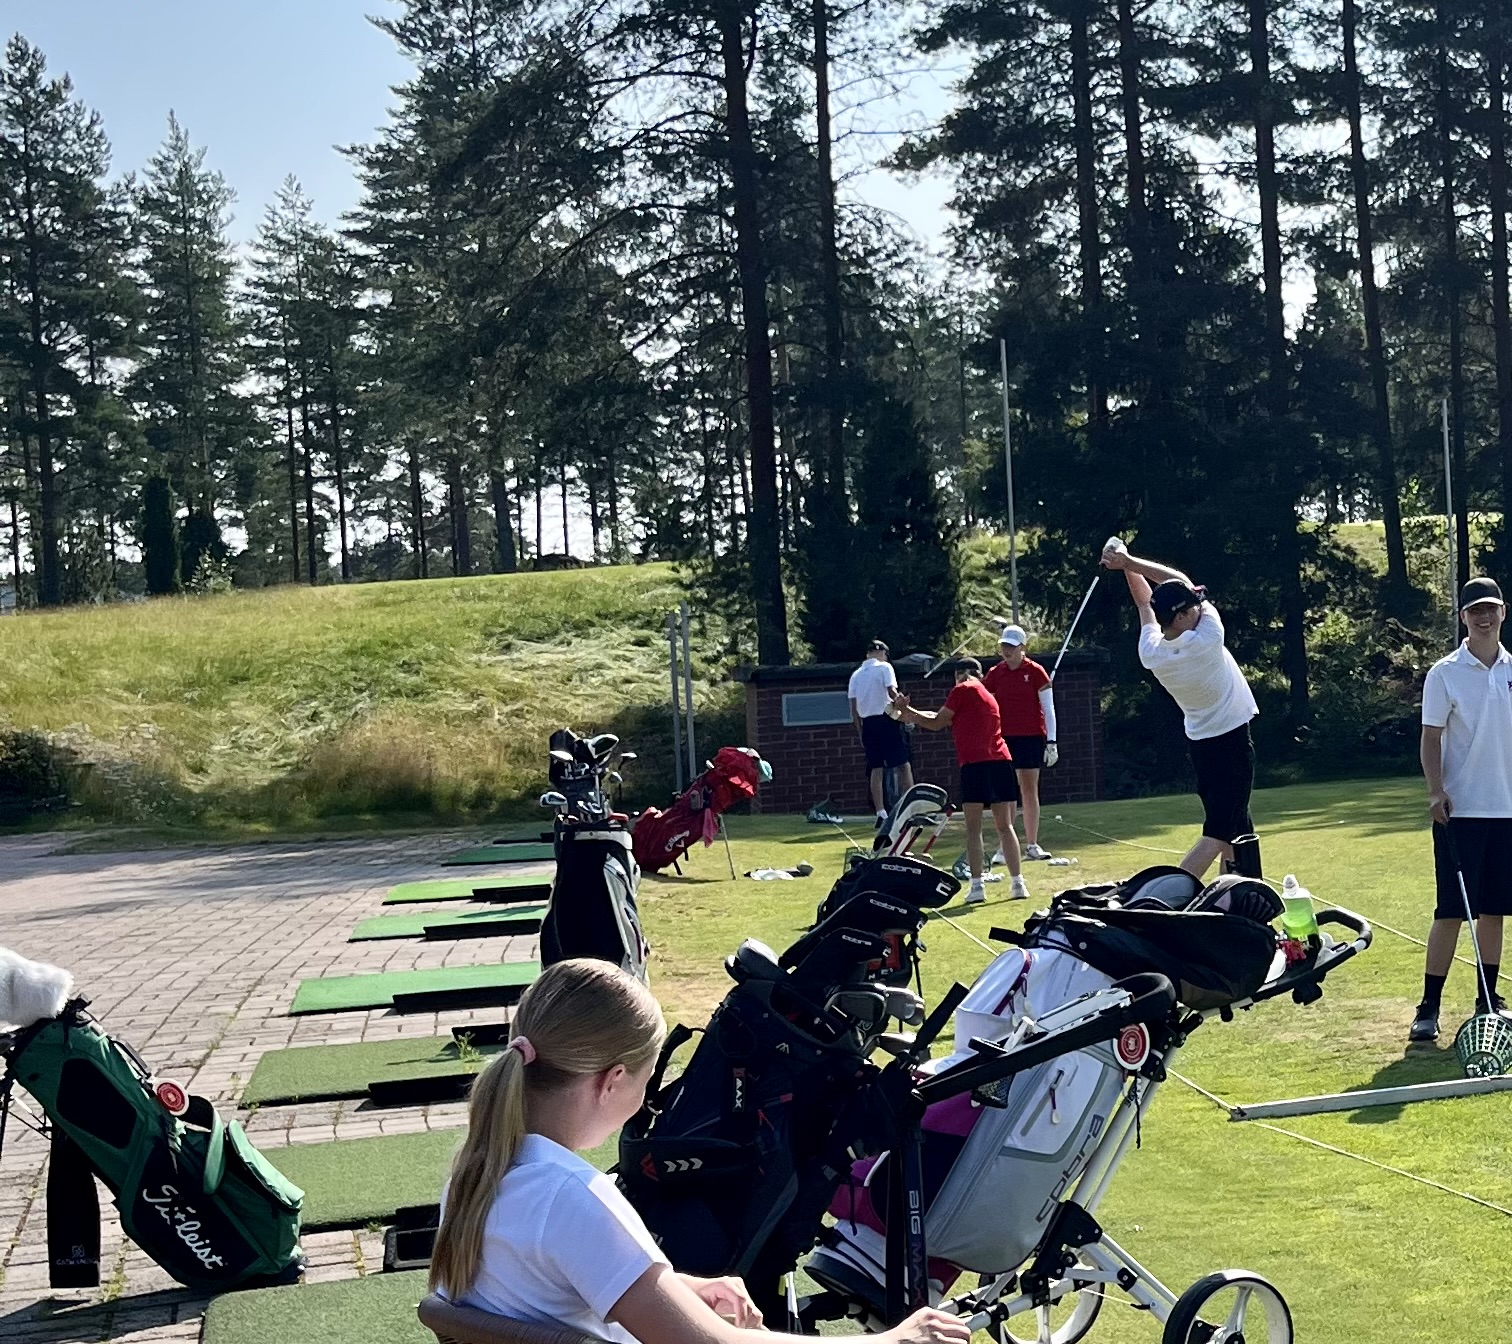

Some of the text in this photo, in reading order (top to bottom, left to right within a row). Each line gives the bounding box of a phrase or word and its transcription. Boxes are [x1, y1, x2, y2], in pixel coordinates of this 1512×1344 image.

[881, 863, 922, 875] cobra
[869, 898, 908, 915] cobra
[1036, 1114, 1104, 1223] cobra
[142, 1184, 224, 1270] Titleist
[909, 1189, 922, 1236] BIG
